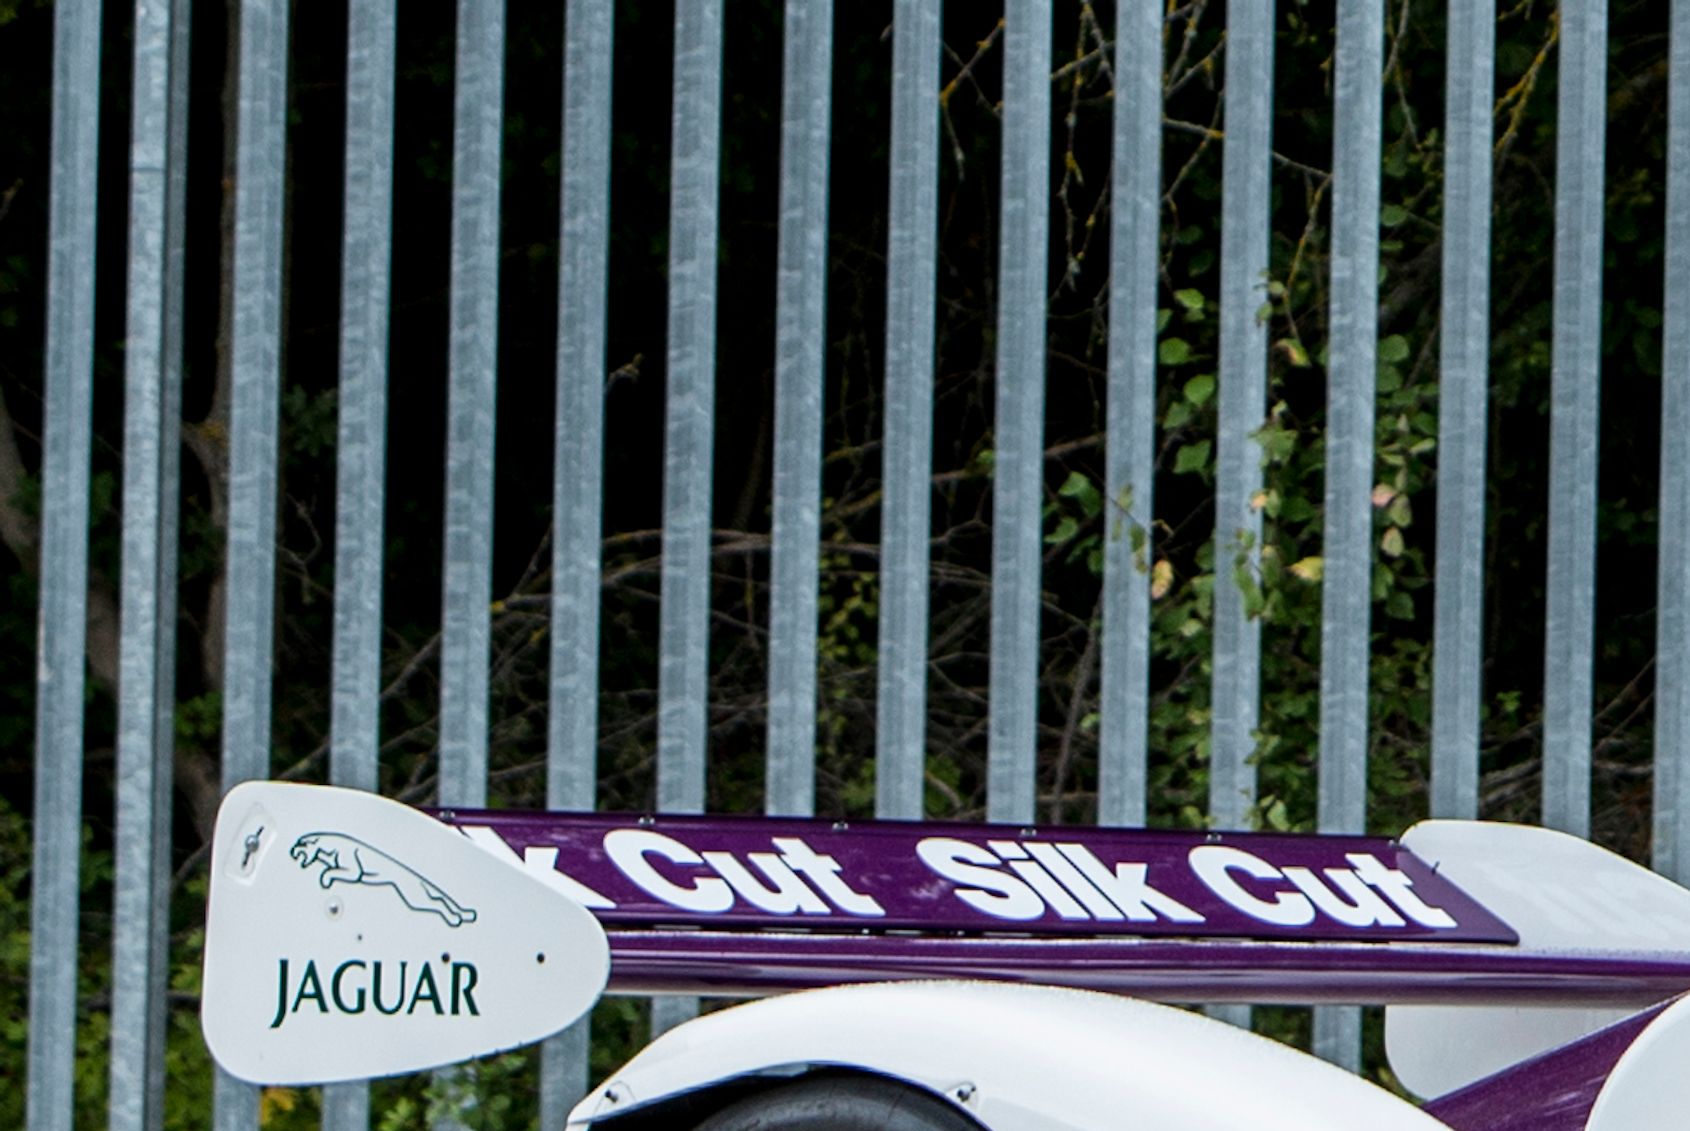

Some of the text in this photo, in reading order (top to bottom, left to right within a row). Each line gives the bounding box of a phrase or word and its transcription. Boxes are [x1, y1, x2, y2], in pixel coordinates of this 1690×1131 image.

[602, 828, 886, 917] Cut
[915, 837, 1205, 924] Silk
[1188, 845, 1458, 929] Cut
[270, 957, 481, 1029] JAGUAR
